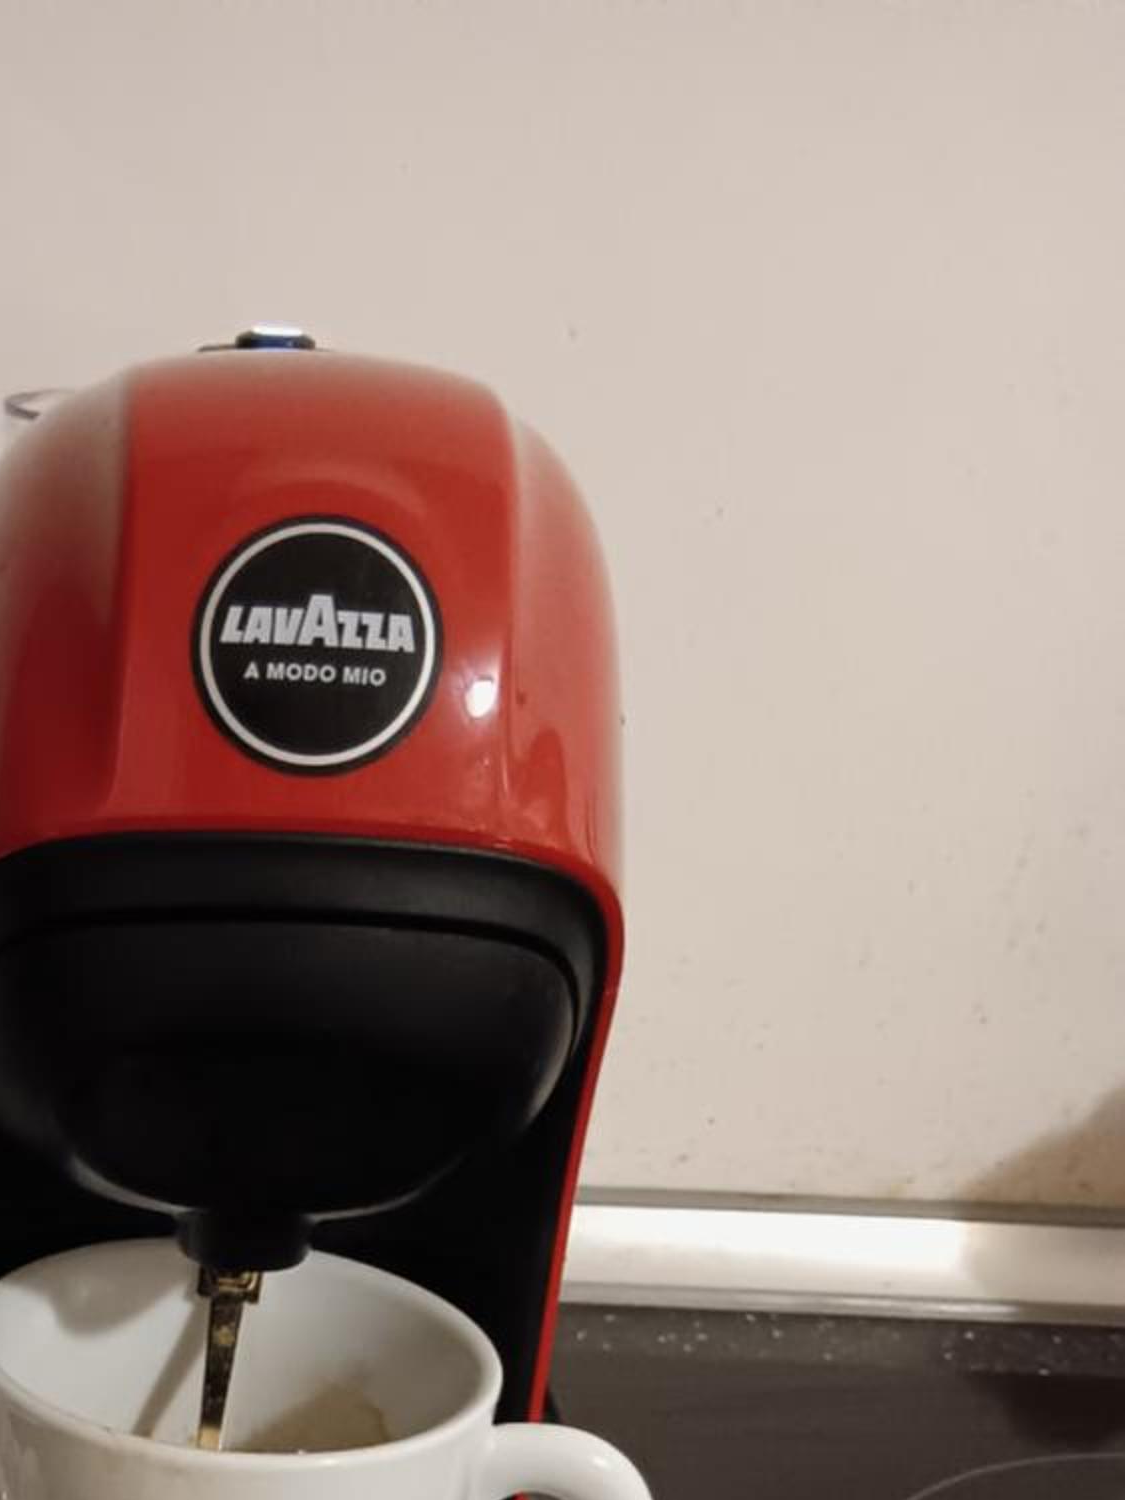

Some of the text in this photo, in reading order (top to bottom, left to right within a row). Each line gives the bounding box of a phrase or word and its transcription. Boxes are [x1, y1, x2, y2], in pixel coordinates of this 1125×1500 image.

[219, 593, 416, 653] LAVAZZA
[243, 661, 387, 687] A MODO MIO
